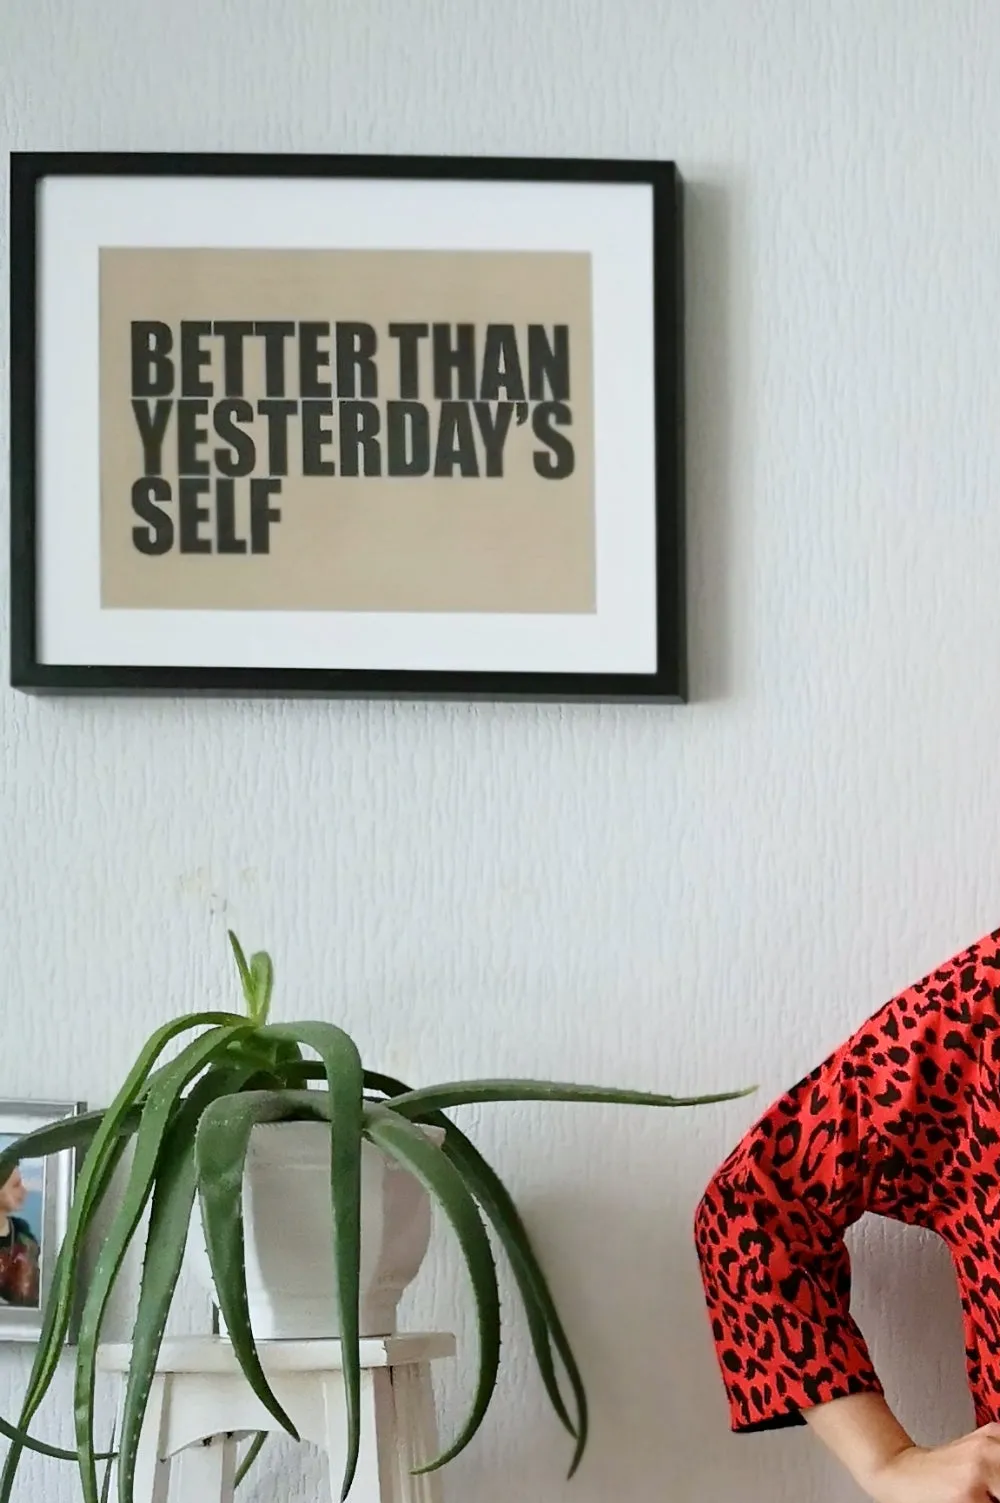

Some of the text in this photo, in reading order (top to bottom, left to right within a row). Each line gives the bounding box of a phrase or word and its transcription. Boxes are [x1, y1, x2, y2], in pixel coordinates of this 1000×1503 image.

[130, 320, 571, 400] BETTER THAN
[131, 399, 575, 480] YESTERDAY'S
[131, 477, 282, 556] SELF
